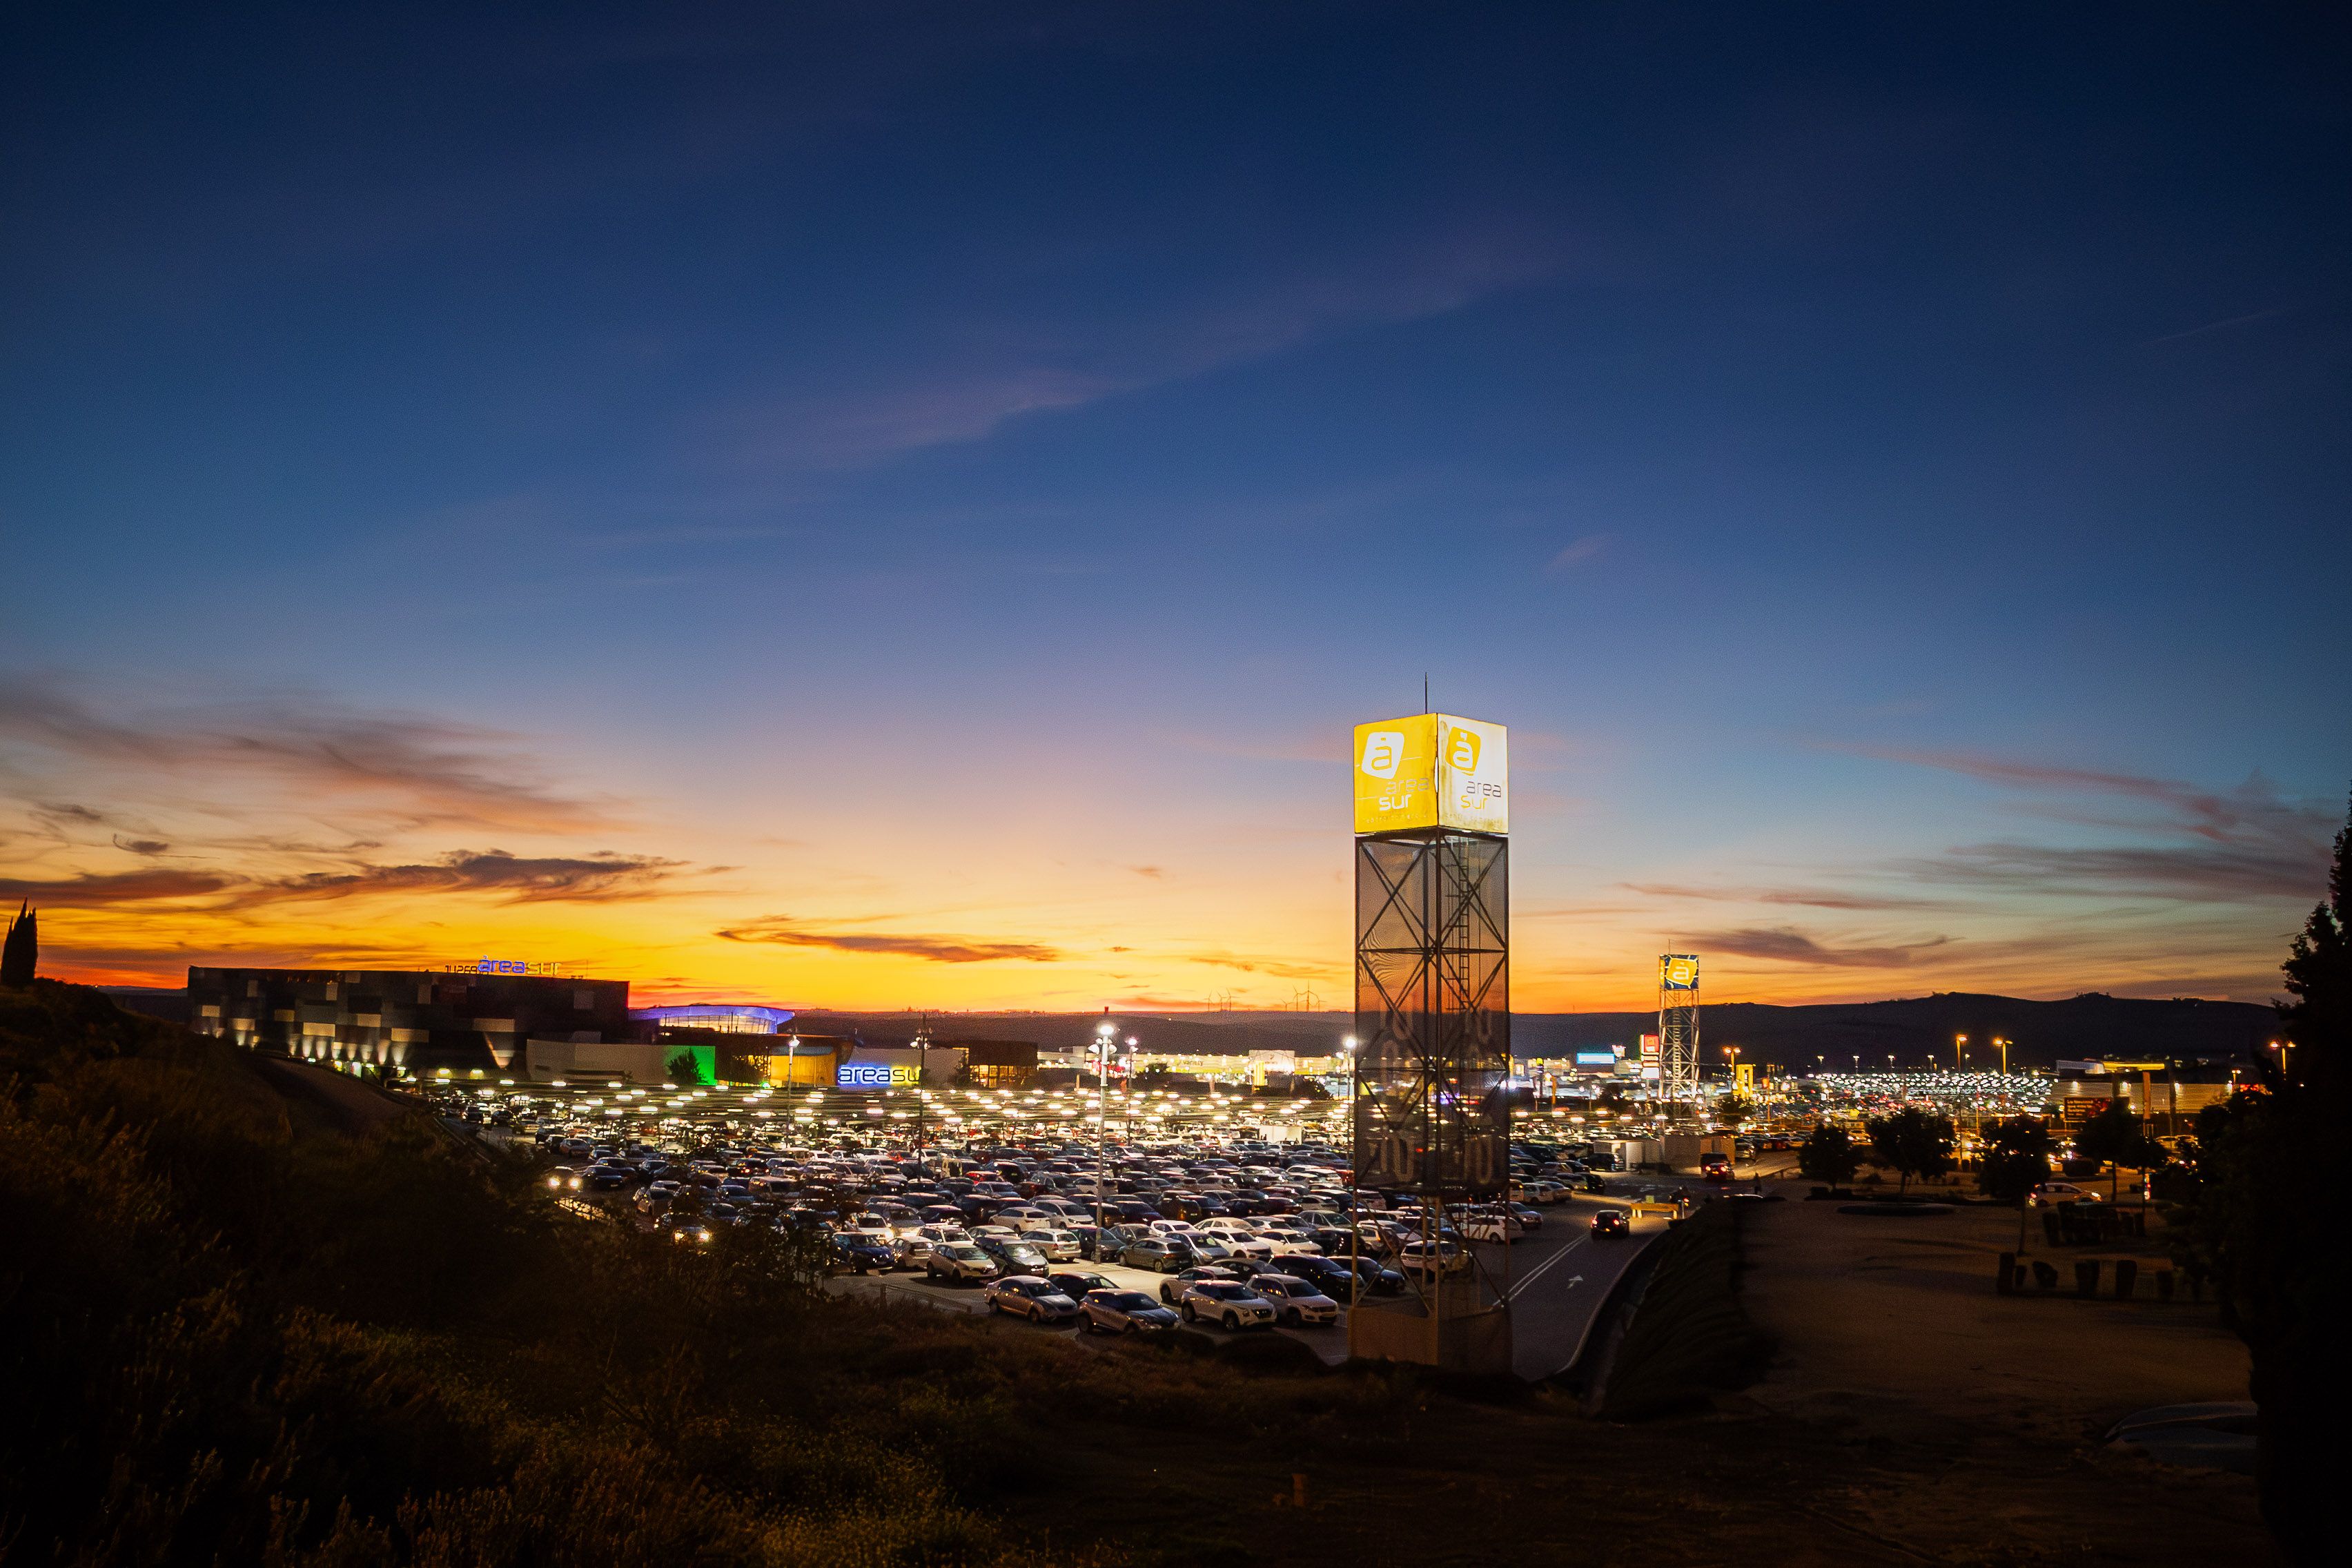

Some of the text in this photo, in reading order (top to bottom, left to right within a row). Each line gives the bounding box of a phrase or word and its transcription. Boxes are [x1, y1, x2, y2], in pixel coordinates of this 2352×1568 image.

[1386, 778, 1429, 794] area
[1467, 781, 1501, 797] area
[1379, 794, 1411, 811] sur
[1460, 795, 1487, 810] sur
[838, 1068, 921, 1083] areasu
